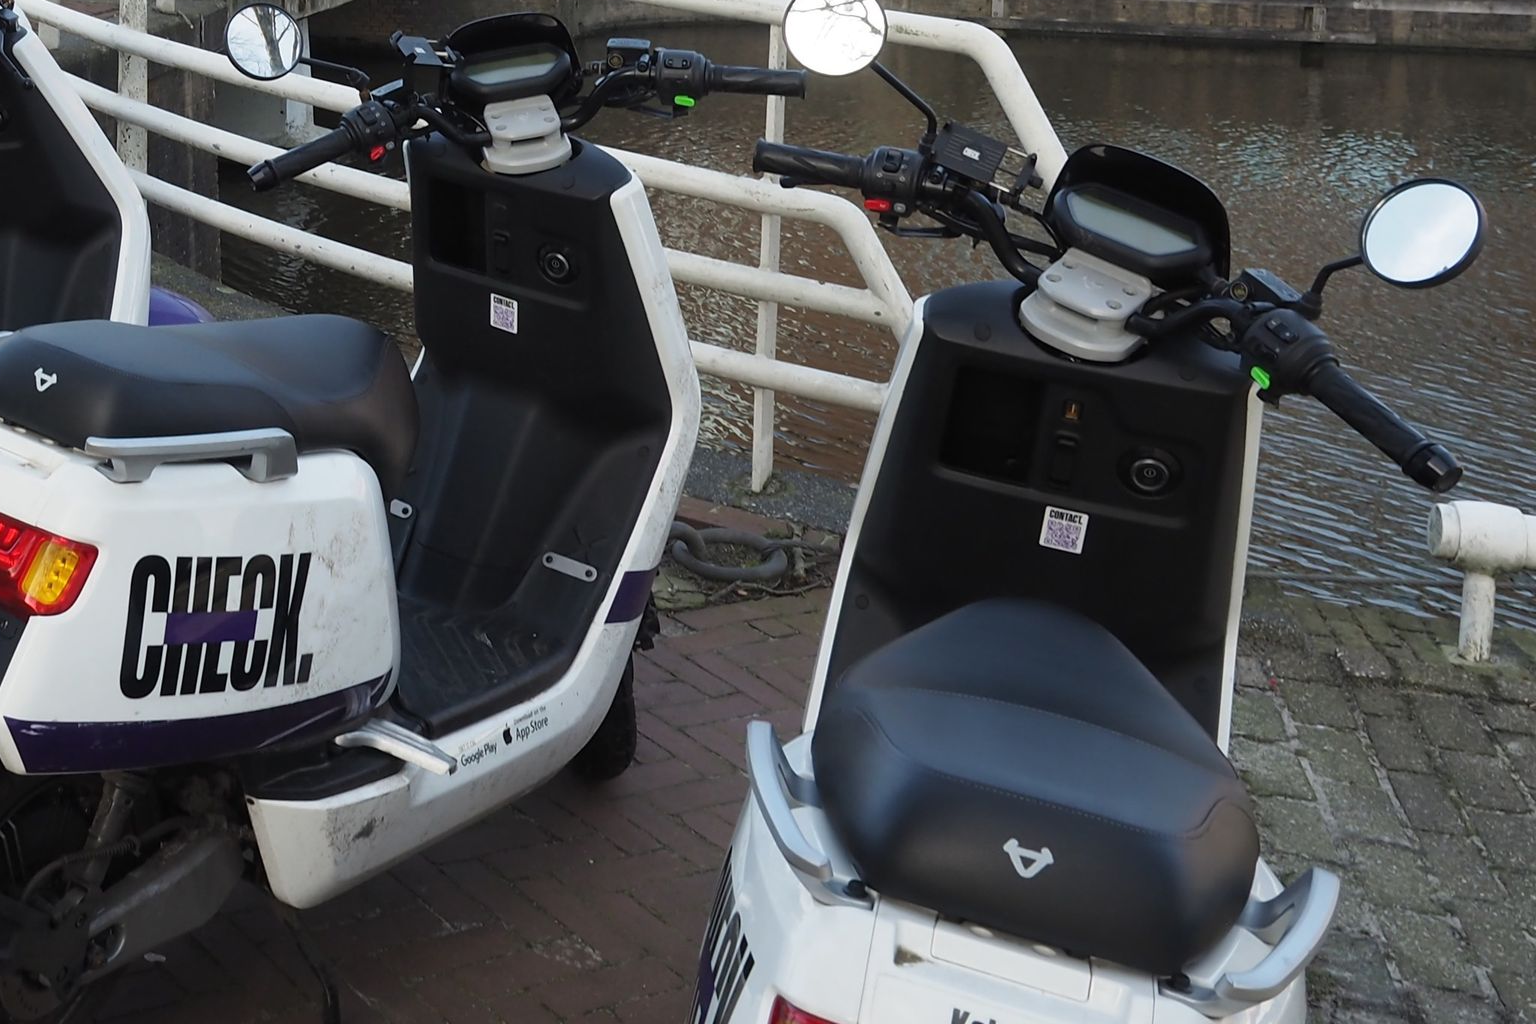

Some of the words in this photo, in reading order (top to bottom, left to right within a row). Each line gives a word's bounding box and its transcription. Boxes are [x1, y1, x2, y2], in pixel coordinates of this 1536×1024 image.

[119, 552, 314, 699] CHECK.
[516, 727, 530, 741] App
[530, 716, 549, 733] Store
[461, 747, 484, 767] Google
[484, 742, 497, 755] Play
